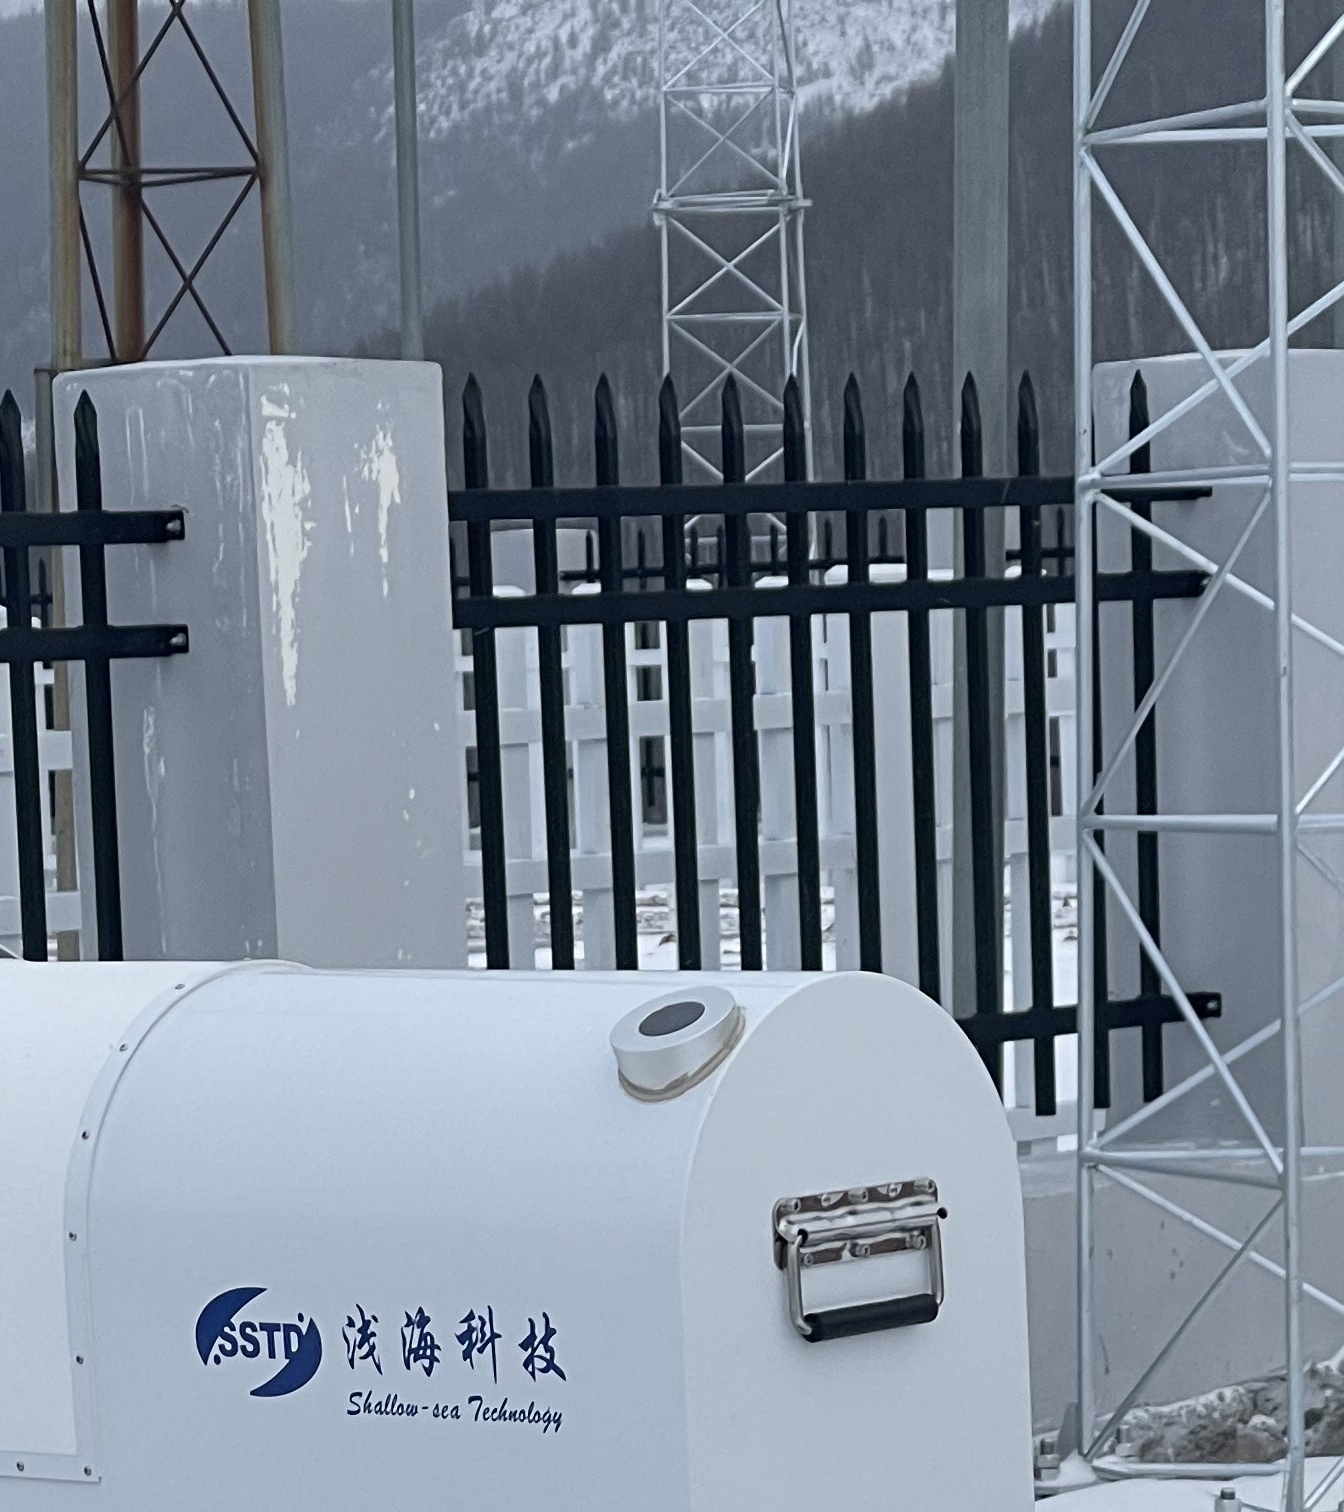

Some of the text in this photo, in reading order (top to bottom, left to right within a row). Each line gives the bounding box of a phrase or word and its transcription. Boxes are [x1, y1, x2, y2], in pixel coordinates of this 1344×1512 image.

[341, 1303, 567, 1384] 浅海科技
[346, 1390, 564, 1433] Shallow-sea Technology
